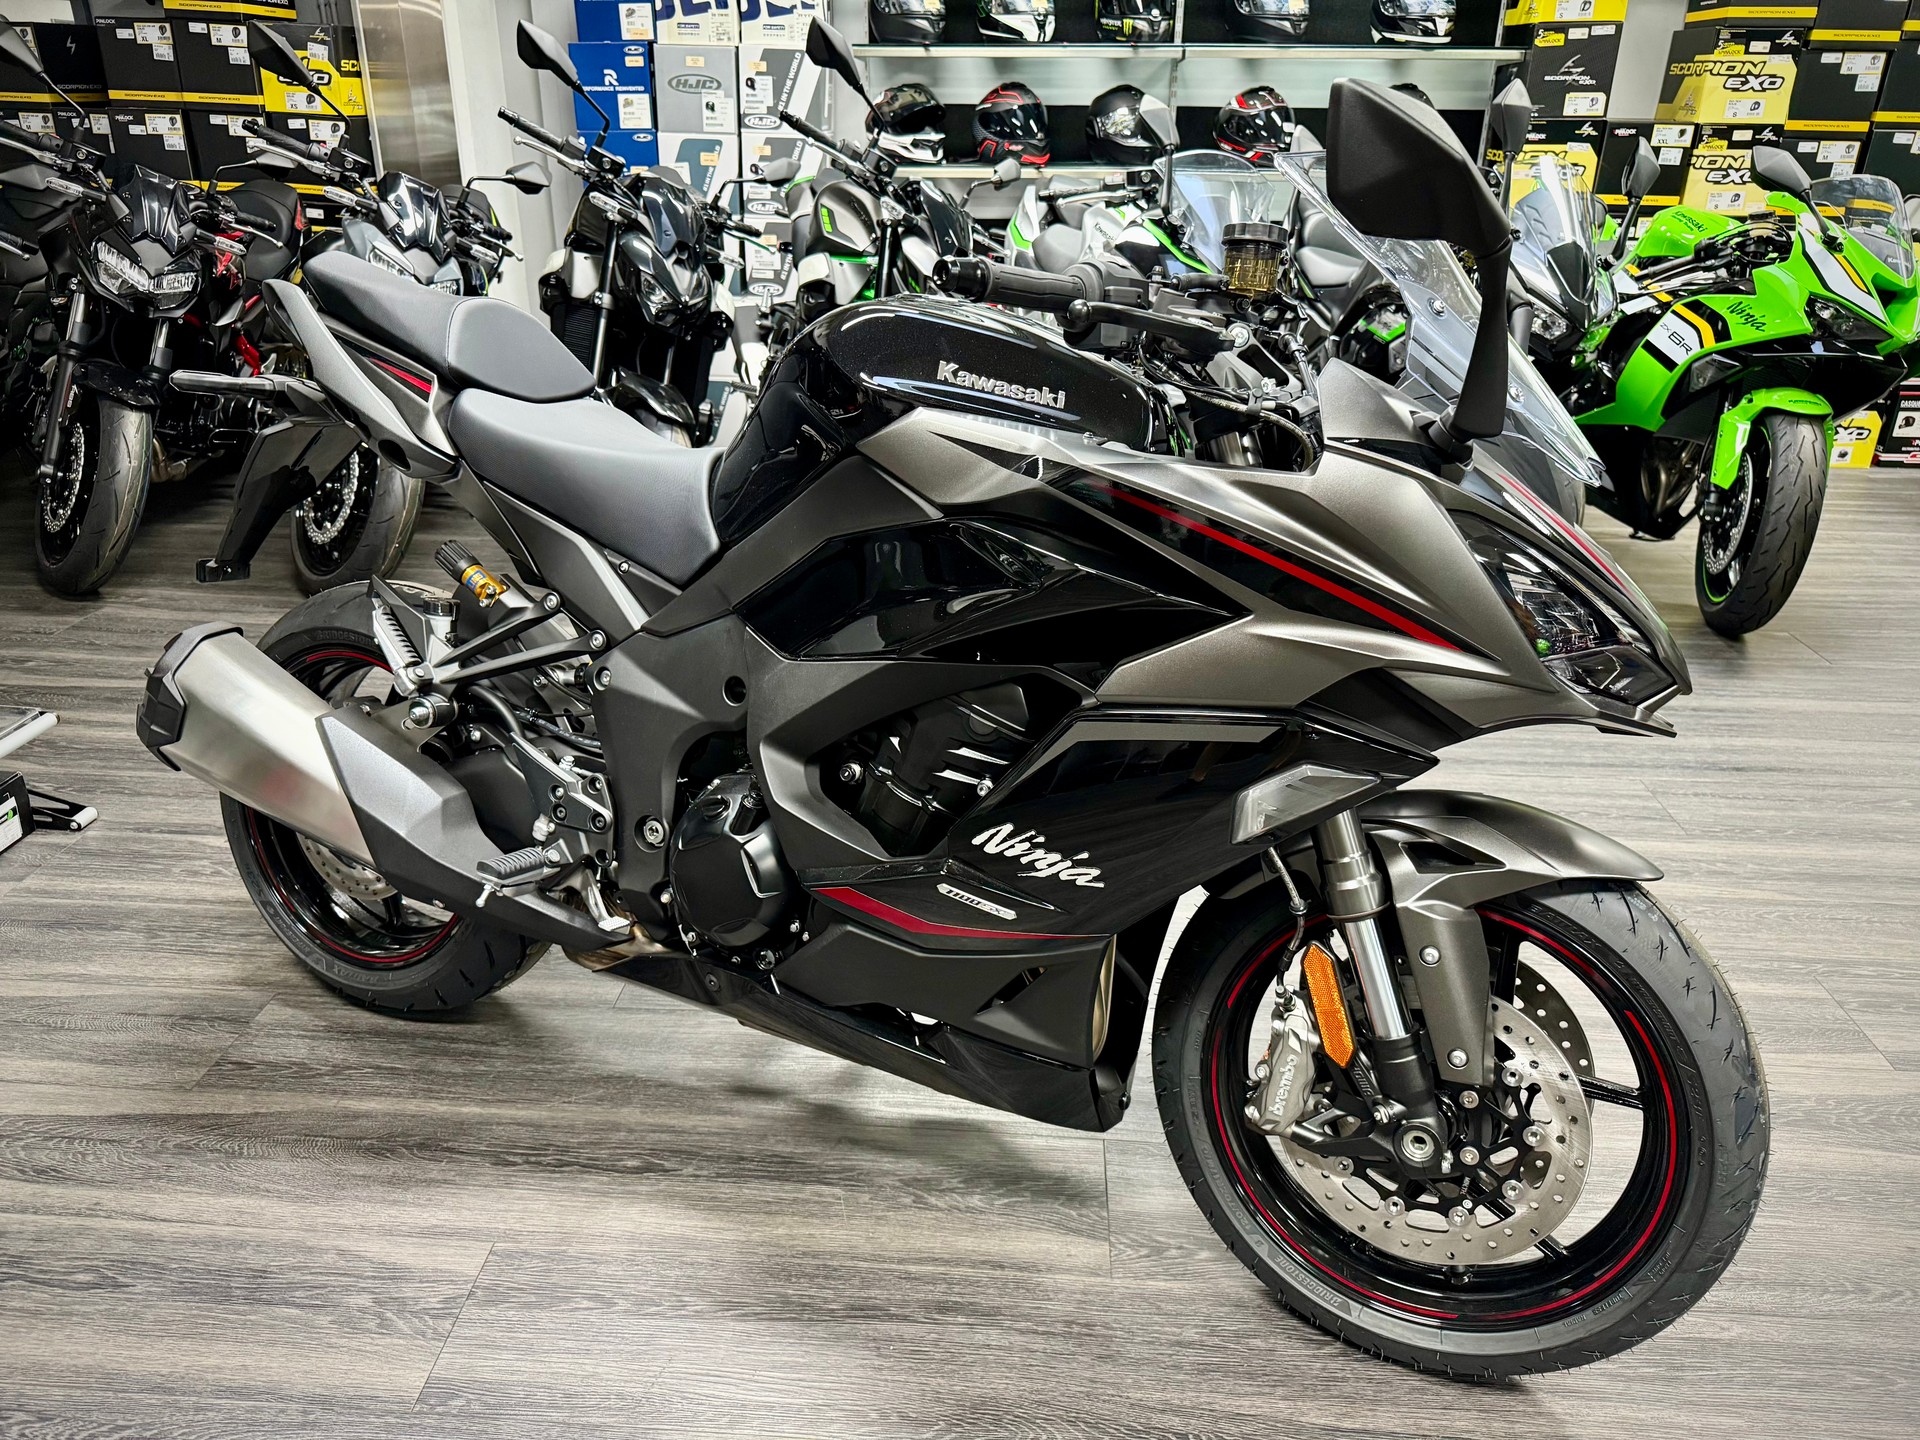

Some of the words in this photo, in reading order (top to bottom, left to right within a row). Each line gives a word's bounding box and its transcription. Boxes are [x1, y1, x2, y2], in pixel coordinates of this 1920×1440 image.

[788, 52, 802, 79] WORLD
[1669, 61, 1765, 76] SCORPION
[1723, 75, 1784, 91] EXO
[1726, 301, 1767, 332] Ninja
[936, 360, 1067, 409] Kawasaki
[971, 822, 1105, 888] Ninja
[1268, 1054, 1299, 1116] brembo
[1273, 1253, 1343, 1308] BRIDGESTONE
